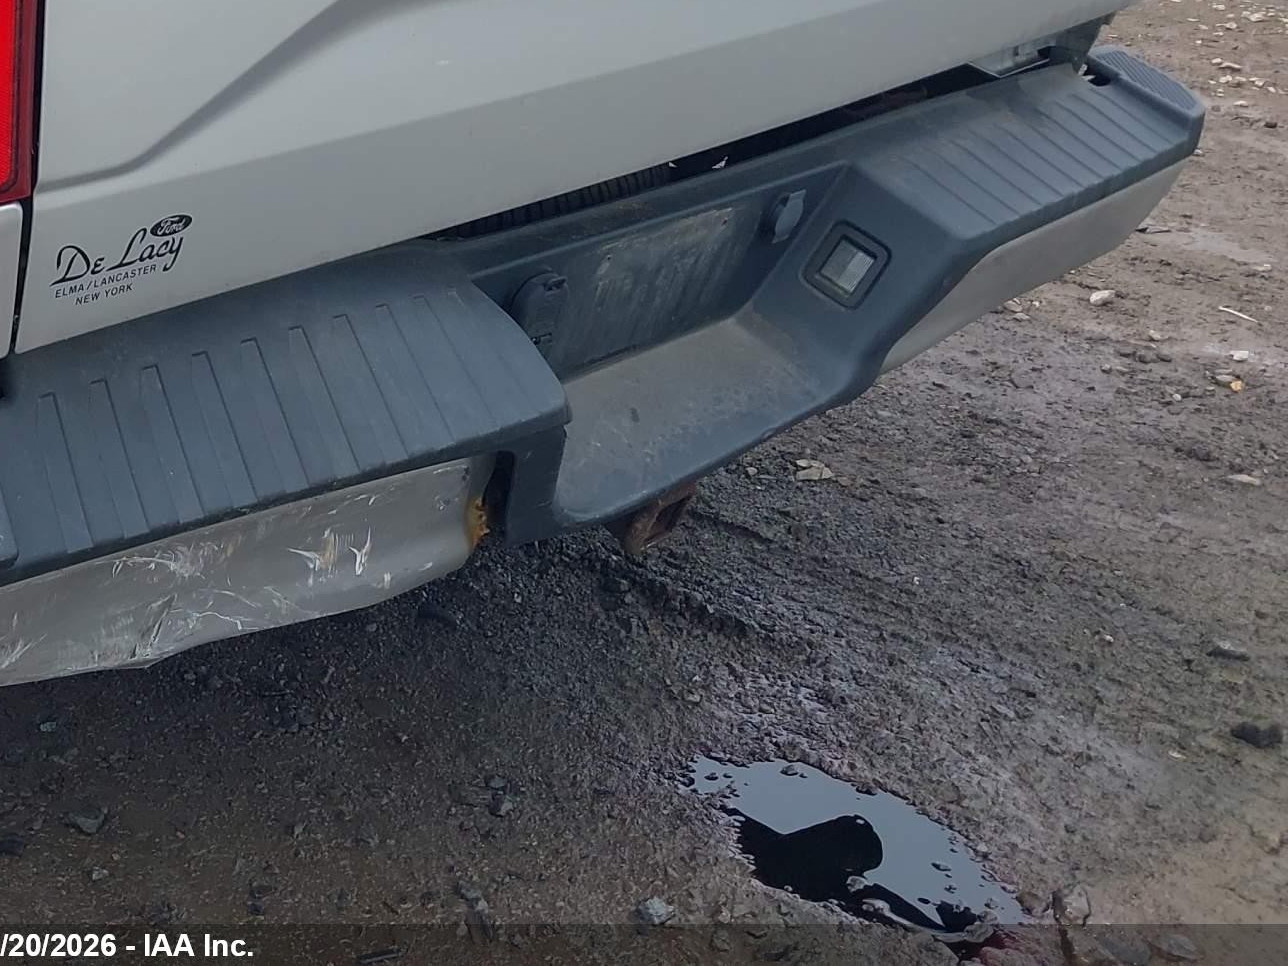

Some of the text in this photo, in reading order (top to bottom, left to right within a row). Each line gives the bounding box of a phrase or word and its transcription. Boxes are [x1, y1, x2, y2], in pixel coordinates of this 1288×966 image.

[49, 227, 184, 286] De Lacy
[55, 264, 157, 299] ELMA/LANCASTER
[75, 283, 133, 306] NEW YORK
